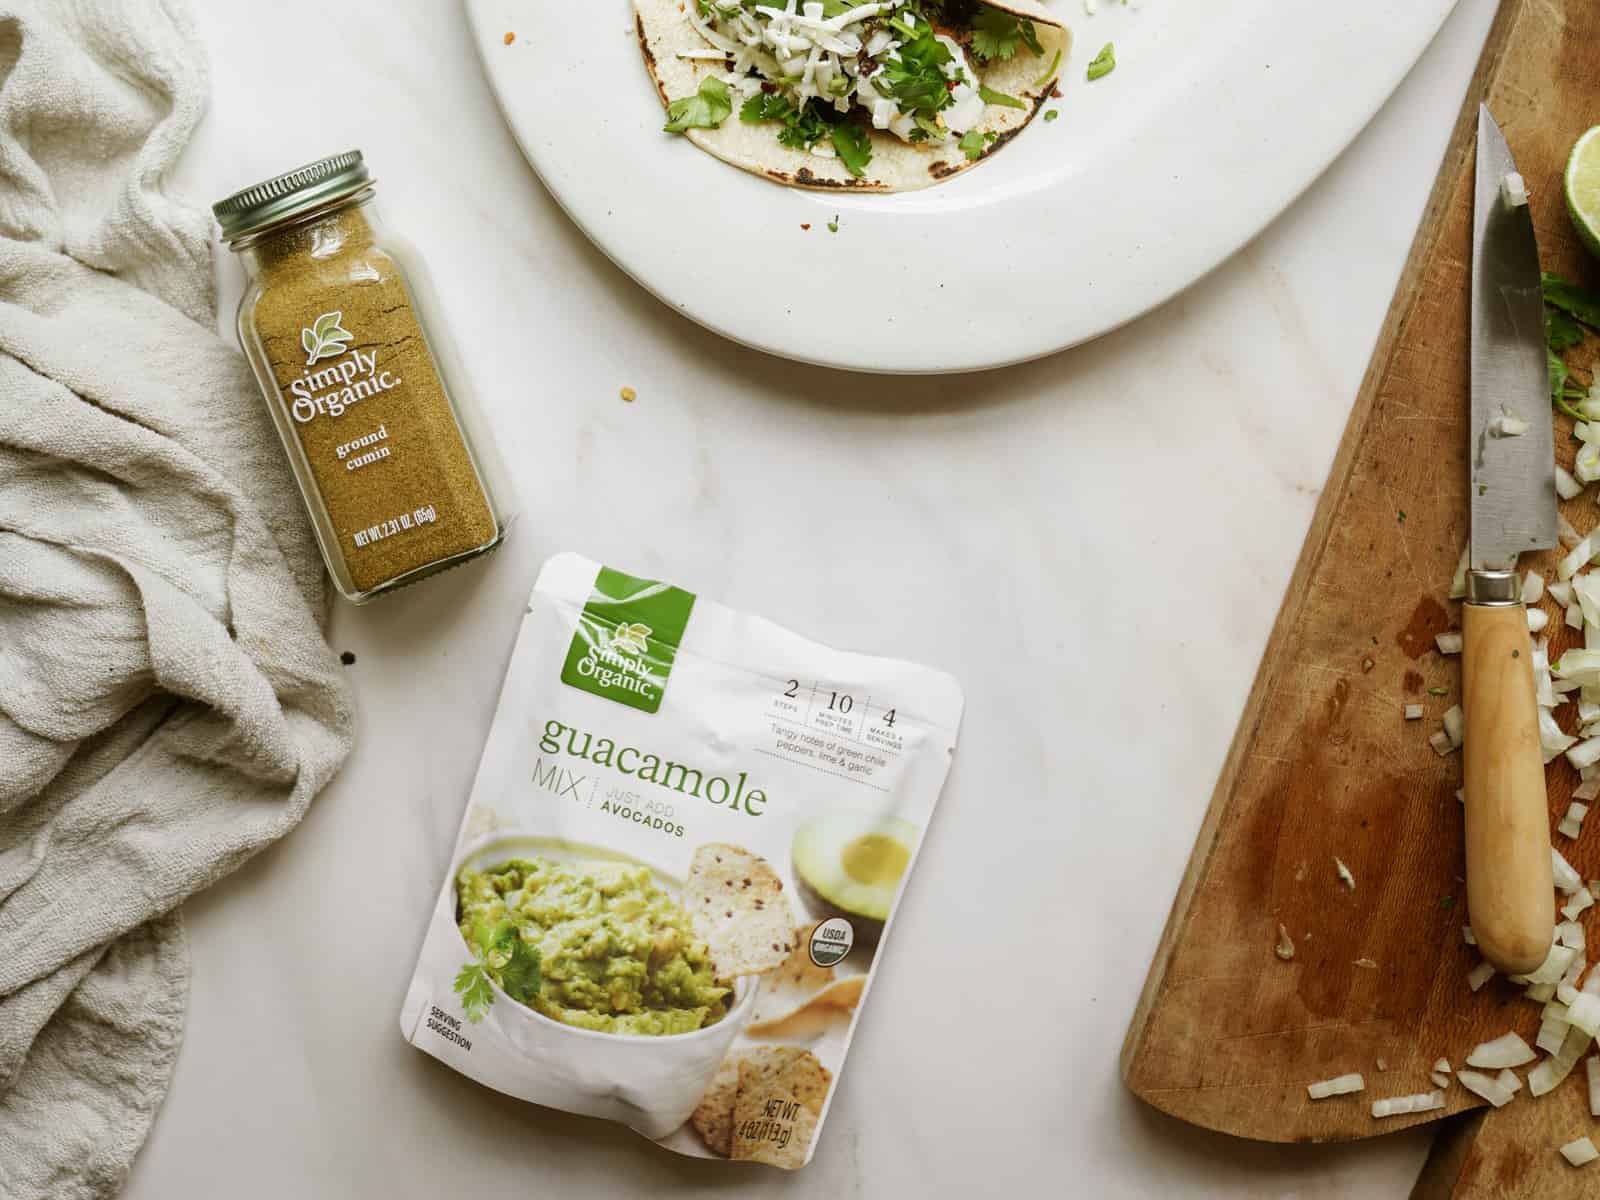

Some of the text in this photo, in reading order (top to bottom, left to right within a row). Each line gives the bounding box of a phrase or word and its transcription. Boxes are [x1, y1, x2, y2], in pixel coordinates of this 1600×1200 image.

[291, 349, 377, 402] Simply
[336, 424, 389, 459] ground
[346, 446, 391, 470] cumin
[588, 646, 654, 679] Simply
[784, 679, 799, 698] 2
[827, 691, 853, 714] 10
[882, 708, 896, 728] 4
[771, 723, 798, 740] Tangy
[801, 732, 825, 748] notes
[826, 741, 837, 751] of
[837, 745, 863, 761] green
[532, 757, 586, 801] MIX
[539, 719, 768, 816] guacamole
[605, 786, 674, 818] JUST ADD
[600, 800, 685, 837] AVOCADOS
[822, 927, 846, 940] USDA
[426, 1018, 472, 1051] SUGGESTION
[431, 1006, 462, 1031] SERVING
[765, 1099, 784, 1118] NET
